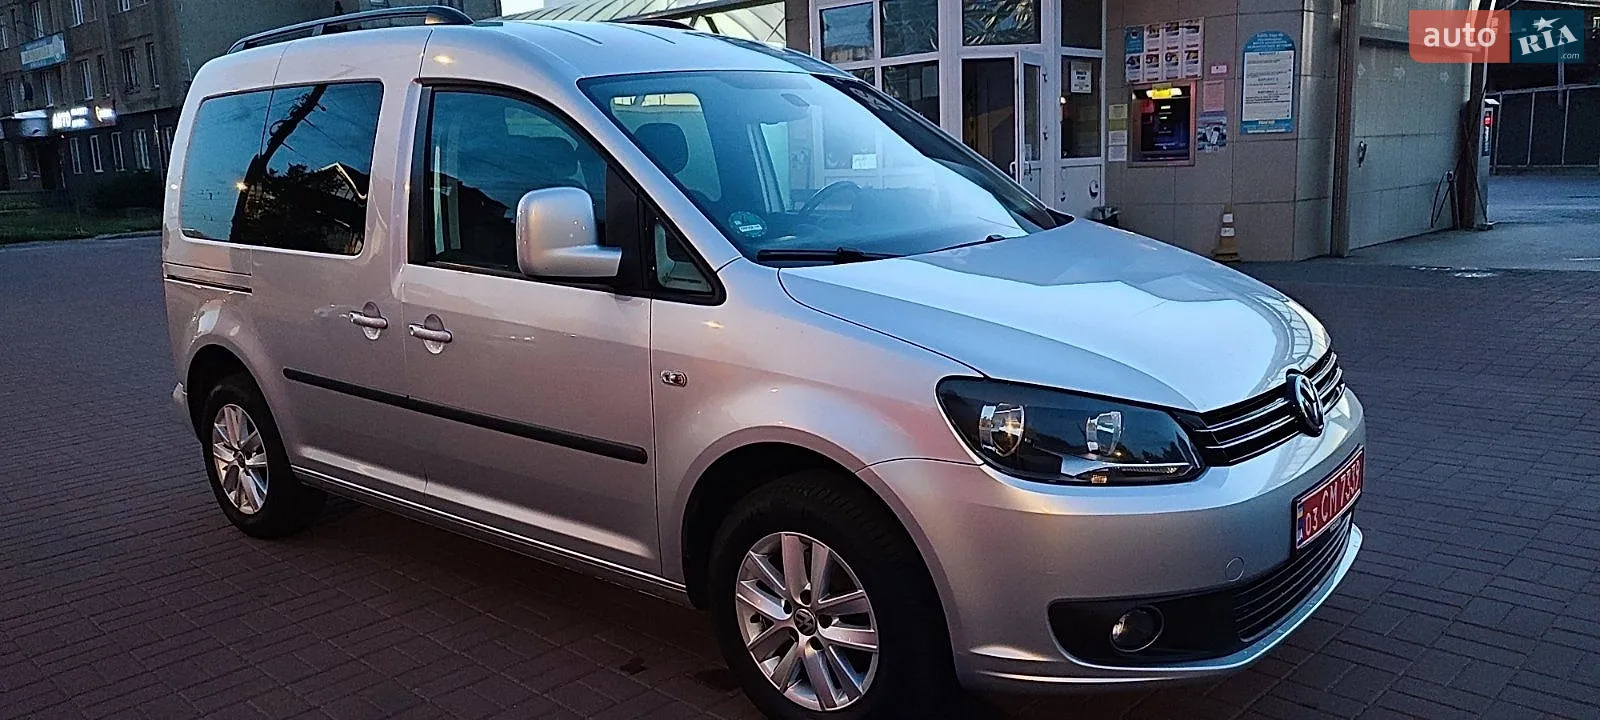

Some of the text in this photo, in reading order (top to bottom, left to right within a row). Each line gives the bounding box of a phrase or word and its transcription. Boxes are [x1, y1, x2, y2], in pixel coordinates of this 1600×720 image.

[1145, 54, 1153, 64] 5
[1165, 52, 1173, 62] 6
[1304, 507, 1319, 536] 03
[1321, 481, 1338, 522] CM
